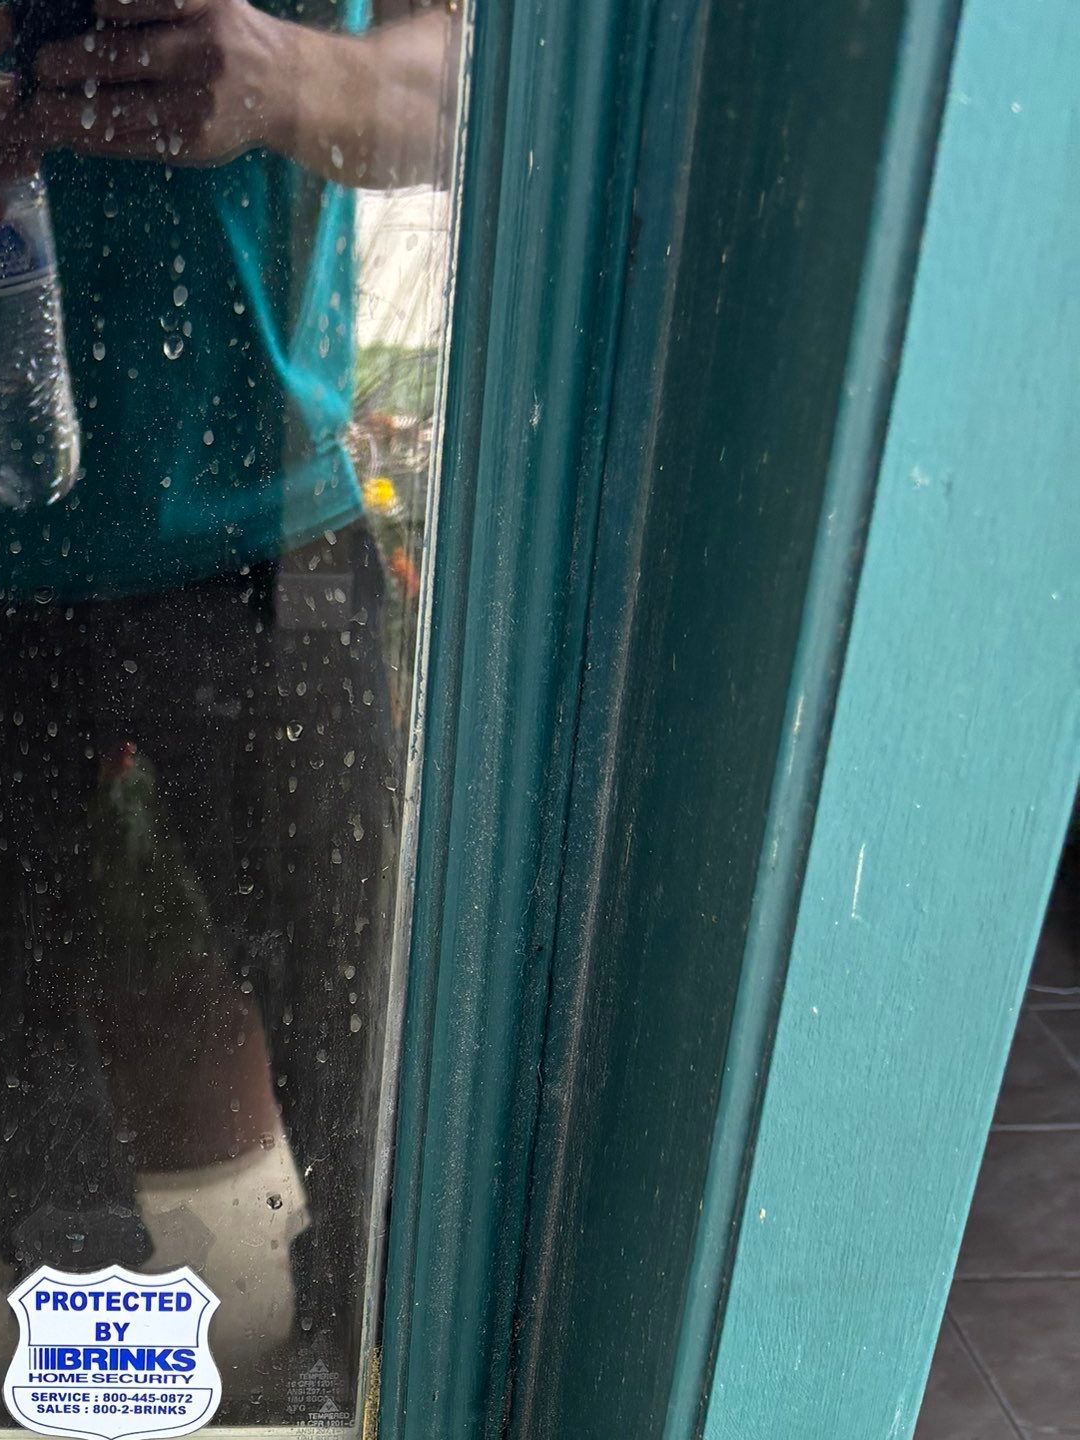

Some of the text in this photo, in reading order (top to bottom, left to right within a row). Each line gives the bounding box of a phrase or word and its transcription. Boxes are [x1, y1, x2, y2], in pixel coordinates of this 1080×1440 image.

[35, 1291, 192, 1312] PROTECTED
[95, 1322, 130, 1342] BY
[57, 1348, 196, 1372] BRINKS
[28, 1373, 195, 1385] HOME SECURITY
[31, 1392, 91, 1403] SERVICE
[102, 1393, 193, 1404] 800-445-0872
[37, 1404, 81, 1414] SALES
[93, 1404, 187, 1415] 800-2-BRINKS
